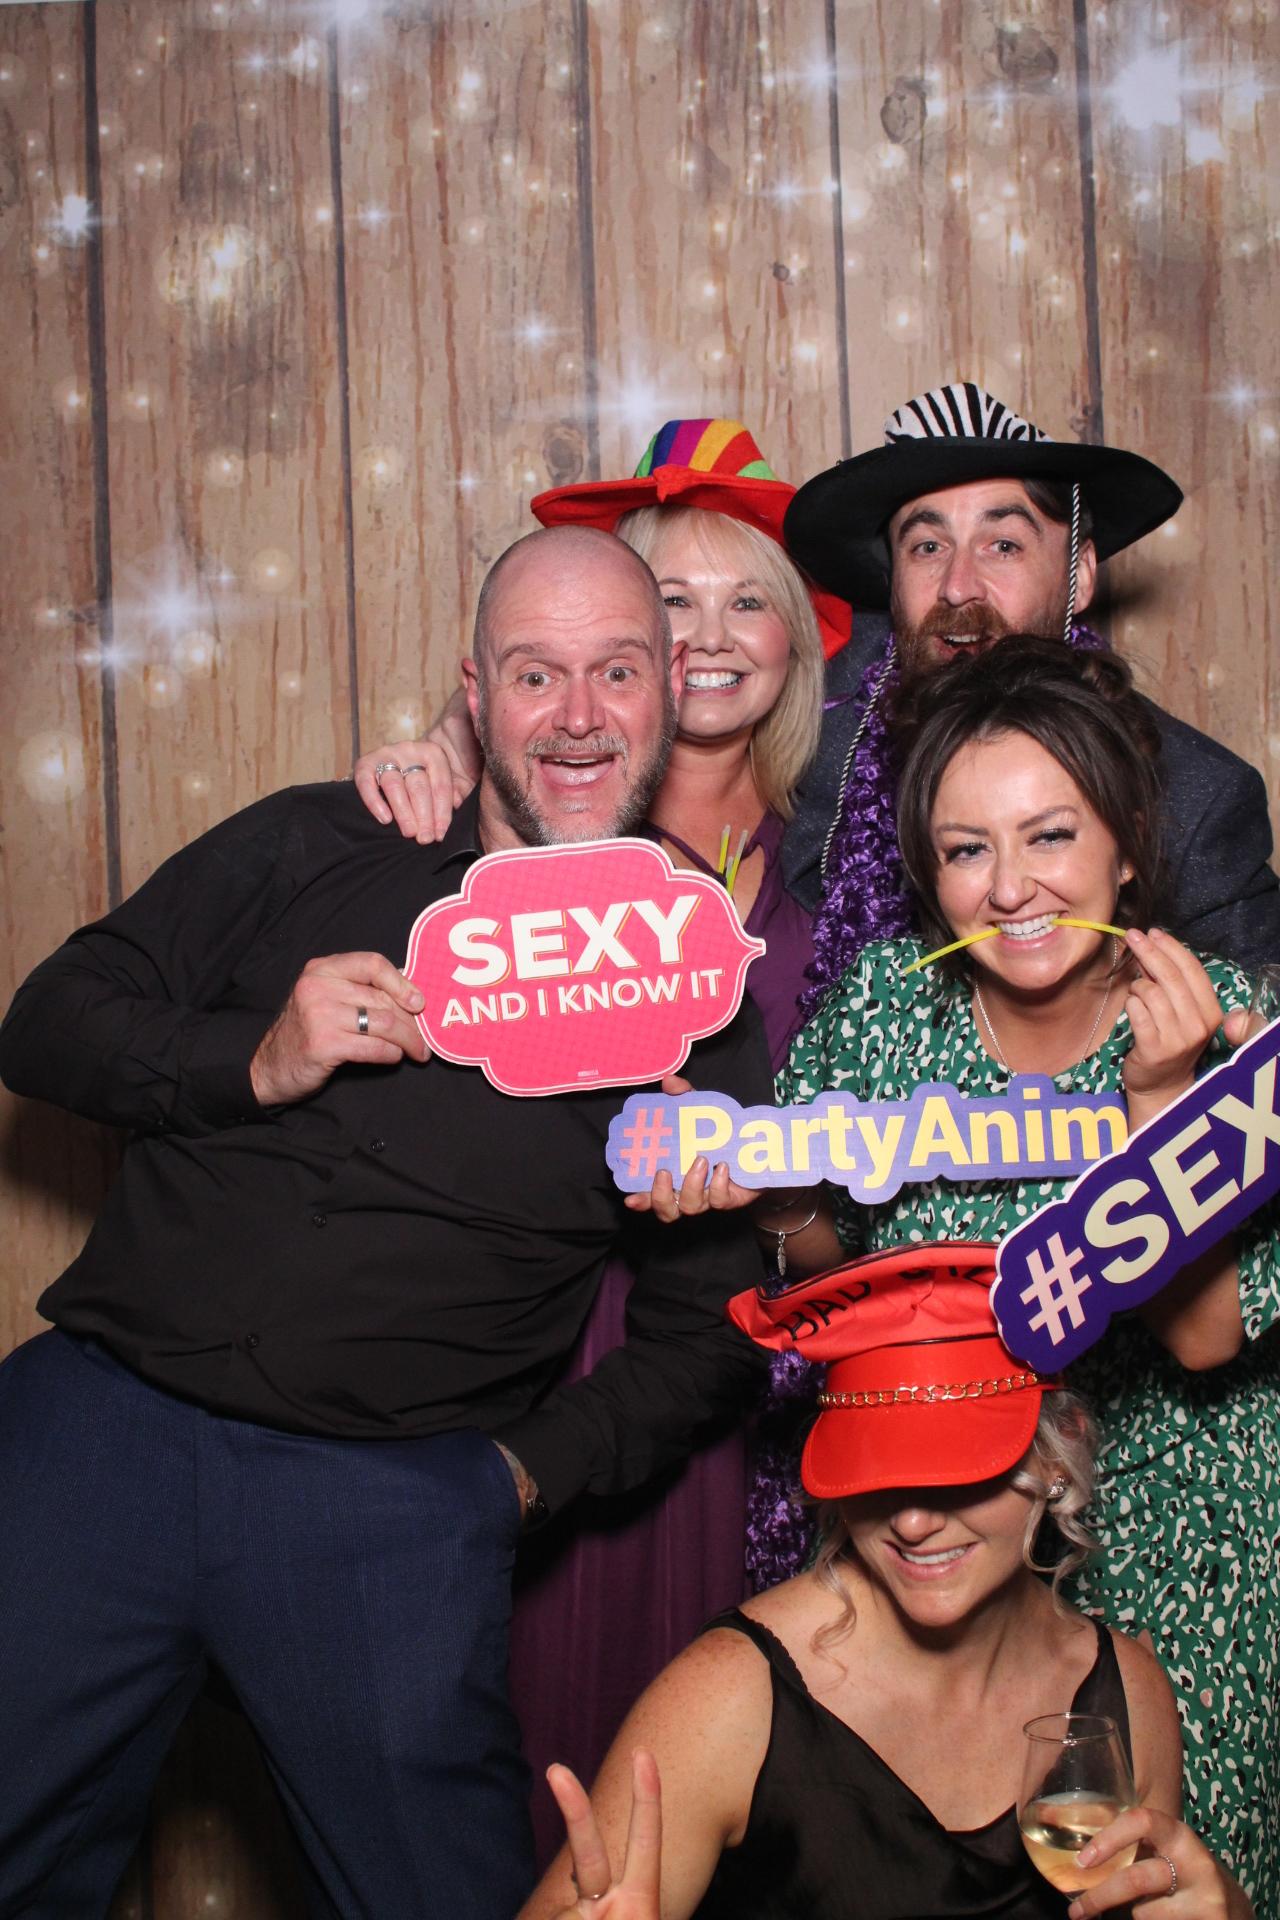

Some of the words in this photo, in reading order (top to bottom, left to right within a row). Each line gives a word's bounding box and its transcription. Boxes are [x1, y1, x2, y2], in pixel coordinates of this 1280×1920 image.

[448, 894, 702, 987] SEXY
[441, 991, 528, 1028] AND
[538, 987, 549, 1017] I
[557, 972, 681, 1015] KNOW
[690, 968, 725, 999] IT
[620, 1087, 1128, 1189] #PartyAnim
[1019, 1053, 1280, 1347] #SEX
